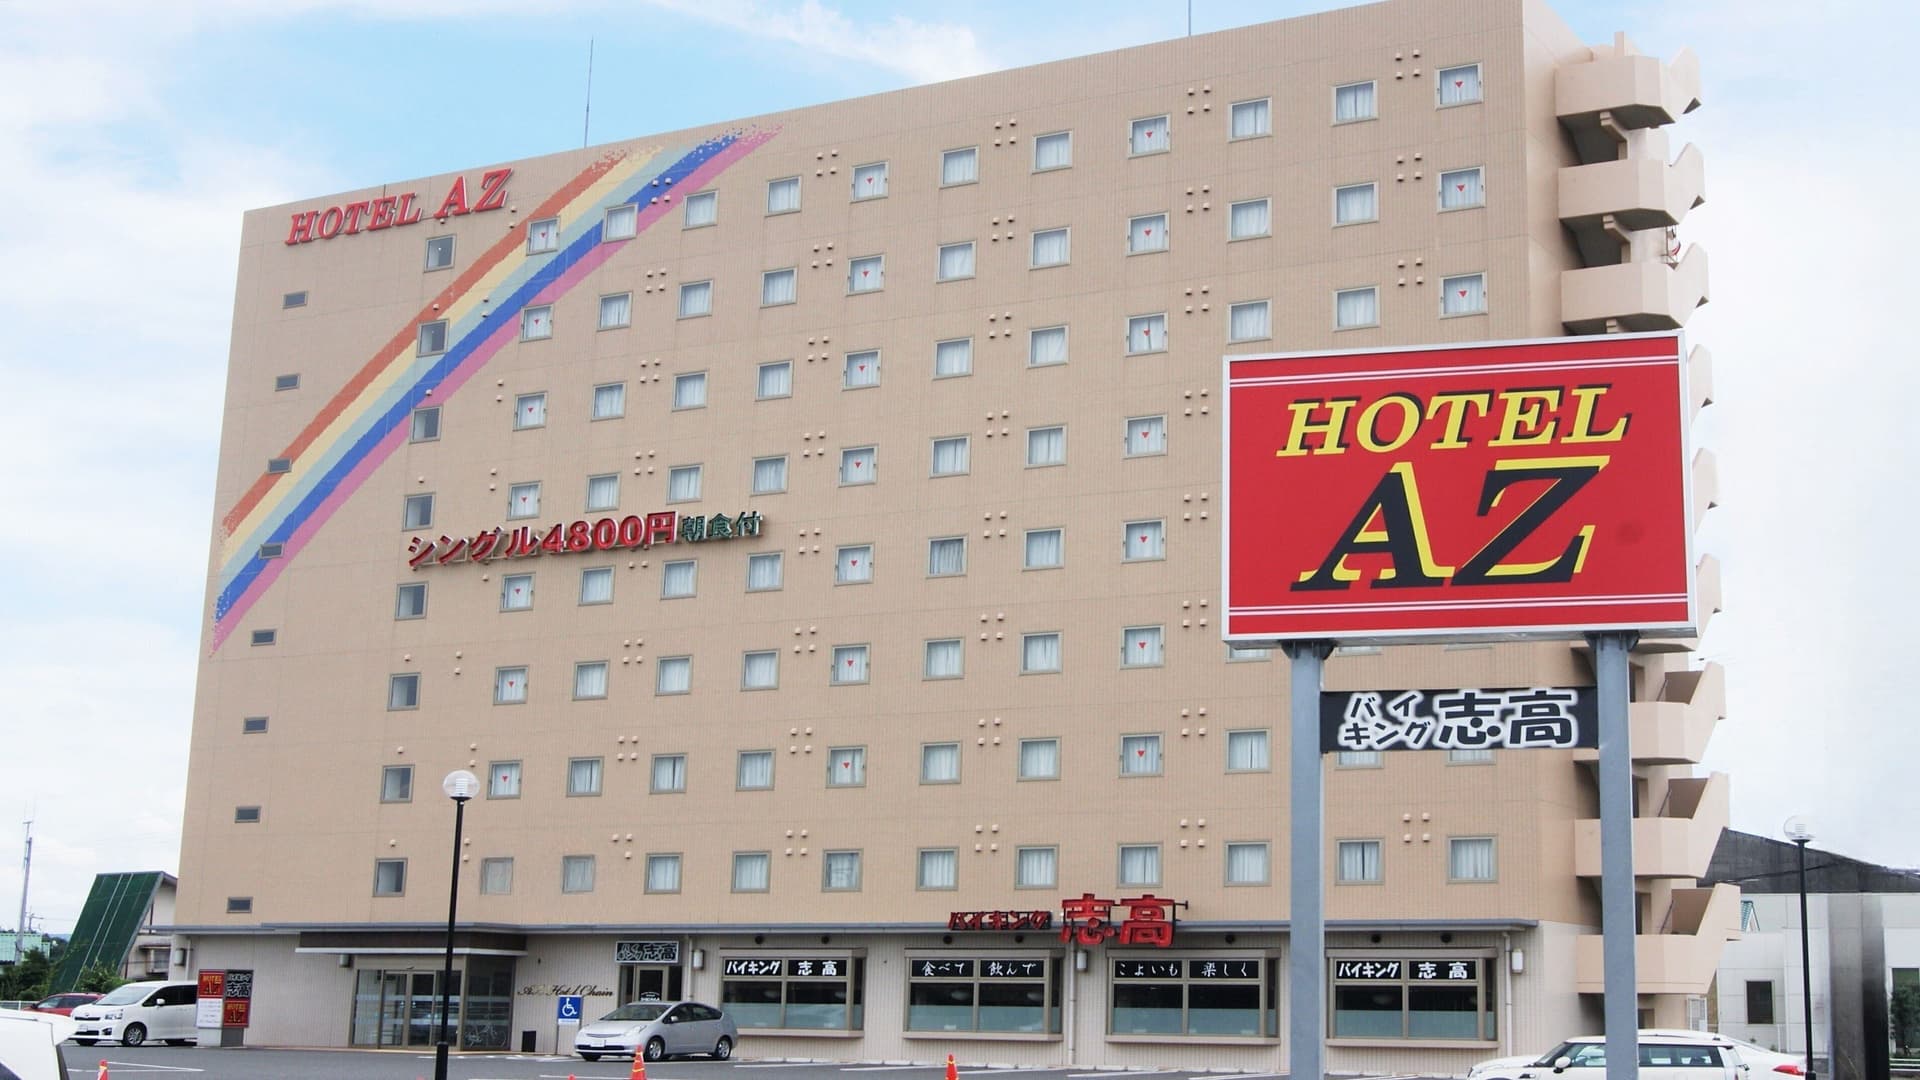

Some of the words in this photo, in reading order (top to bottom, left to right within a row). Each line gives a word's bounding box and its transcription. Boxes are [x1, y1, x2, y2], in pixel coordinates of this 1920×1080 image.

[285, 192, 422, 245] HOTEL
[433, 168, 514, 219] AZ
[1276, 383, 1632, 457] HOTEL
[681, 510, 764, 542] 朝食付
[1289, 455, 1610, 592] AZ
[1437, 689, 1573, 746] 志高
[948, 910, 1051, 931] バイキング
[1060, 893, 1175, 948] 志高
[643, 943, 677, 961] 志高
[726, 960, 781, 975] バイキング
[922, 961, 965, 977] 食べて
[988, 961, 1037, 977] 飲んで
[1119, 963, 1178, 977] こよいも
[1201, 962, 1247, 977] 楽しく
[1338, 962, 1400, 978] バイキング
[580, 985, 613, 997] Chain
